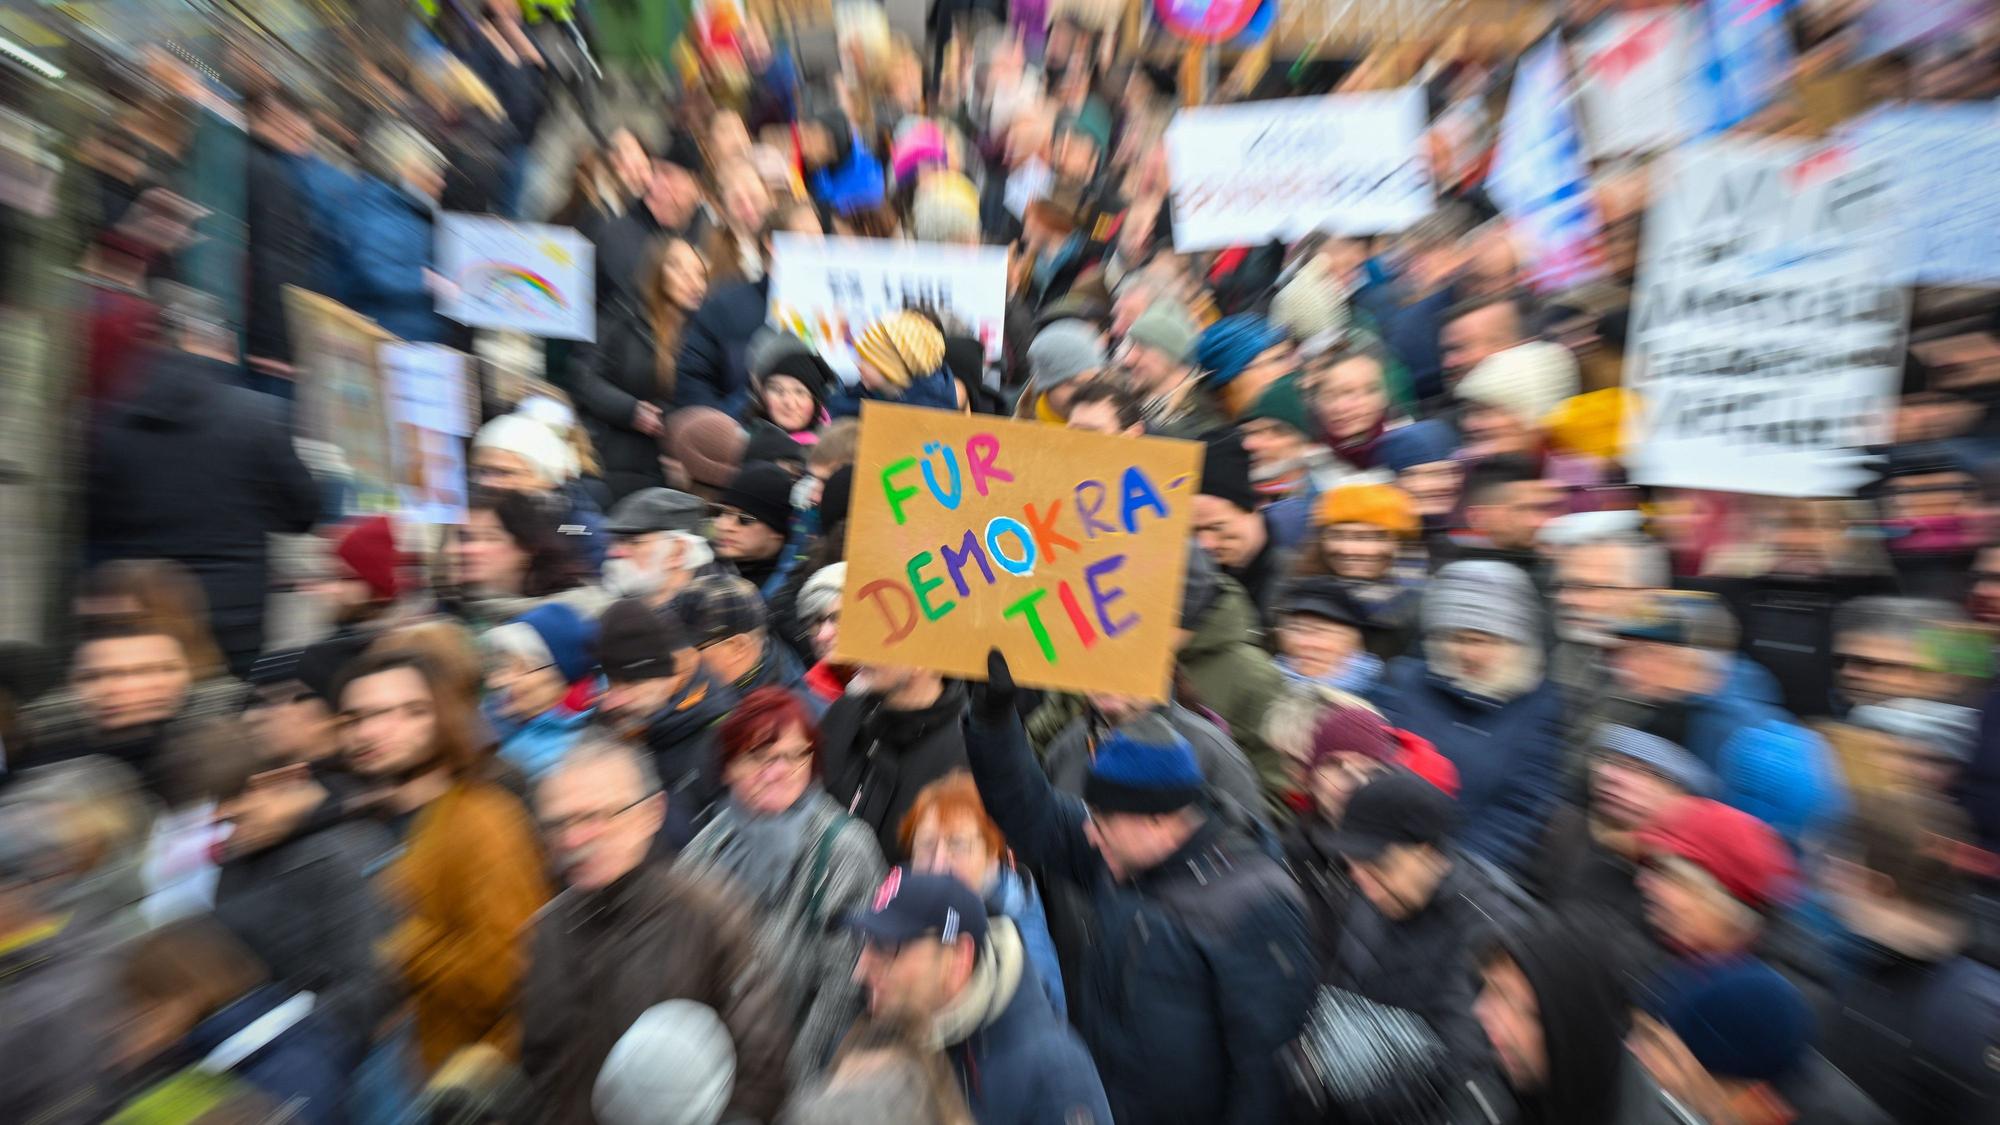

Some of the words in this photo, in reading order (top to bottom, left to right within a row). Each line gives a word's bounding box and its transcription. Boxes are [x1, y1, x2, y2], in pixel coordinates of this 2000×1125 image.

[880, 433, 1015, 525] FÜR
[857, 466, 1187, 646] DEMOKRA-
[1003, 554, 1141, 664] TIE
